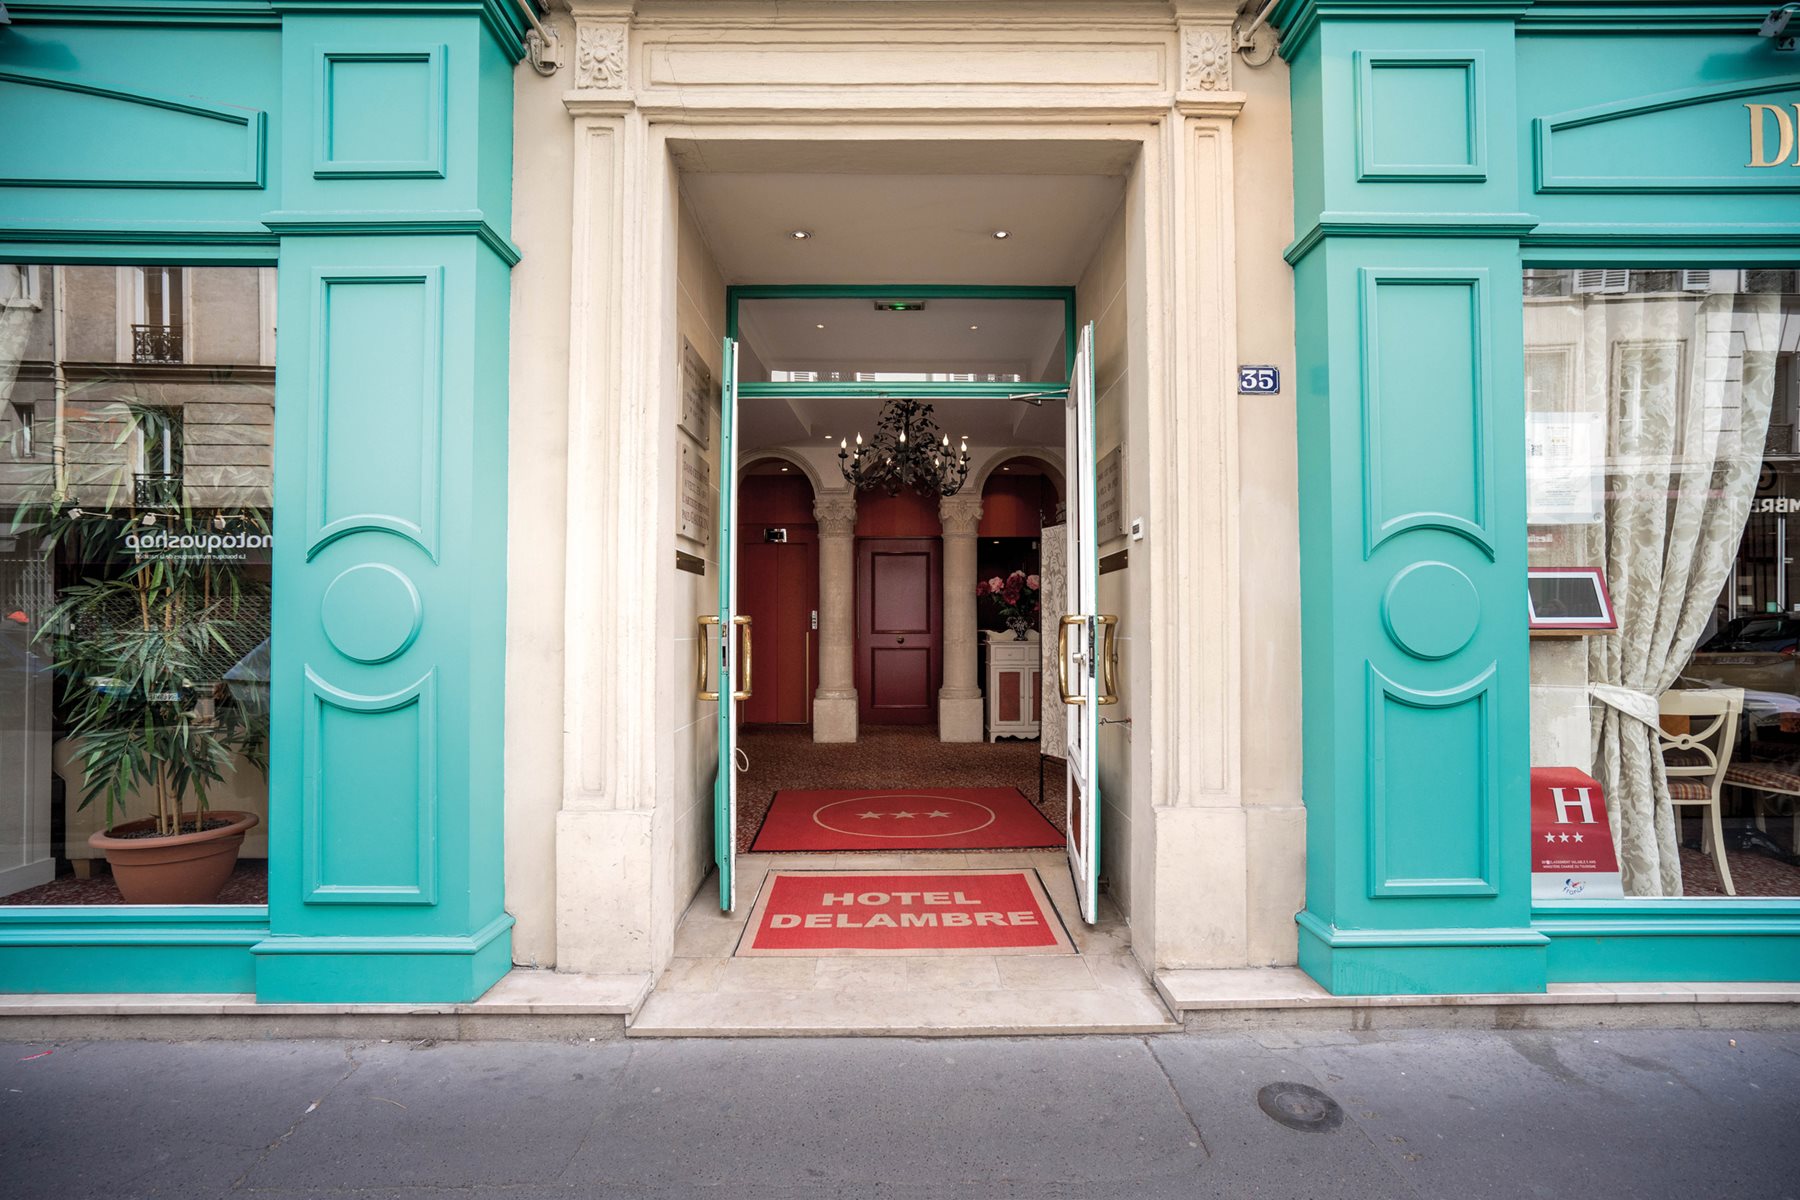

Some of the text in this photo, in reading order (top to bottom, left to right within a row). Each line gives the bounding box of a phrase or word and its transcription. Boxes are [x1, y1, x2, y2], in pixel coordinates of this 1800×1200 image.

[1743, 103, 1800, 168] D
[1241, 369, 1274, 390] 35
[1548, 787, 1599, 824] H
[822, 891, 981, 906] HOTEL
[769, 910, 1039, 929] DELAMBRE
